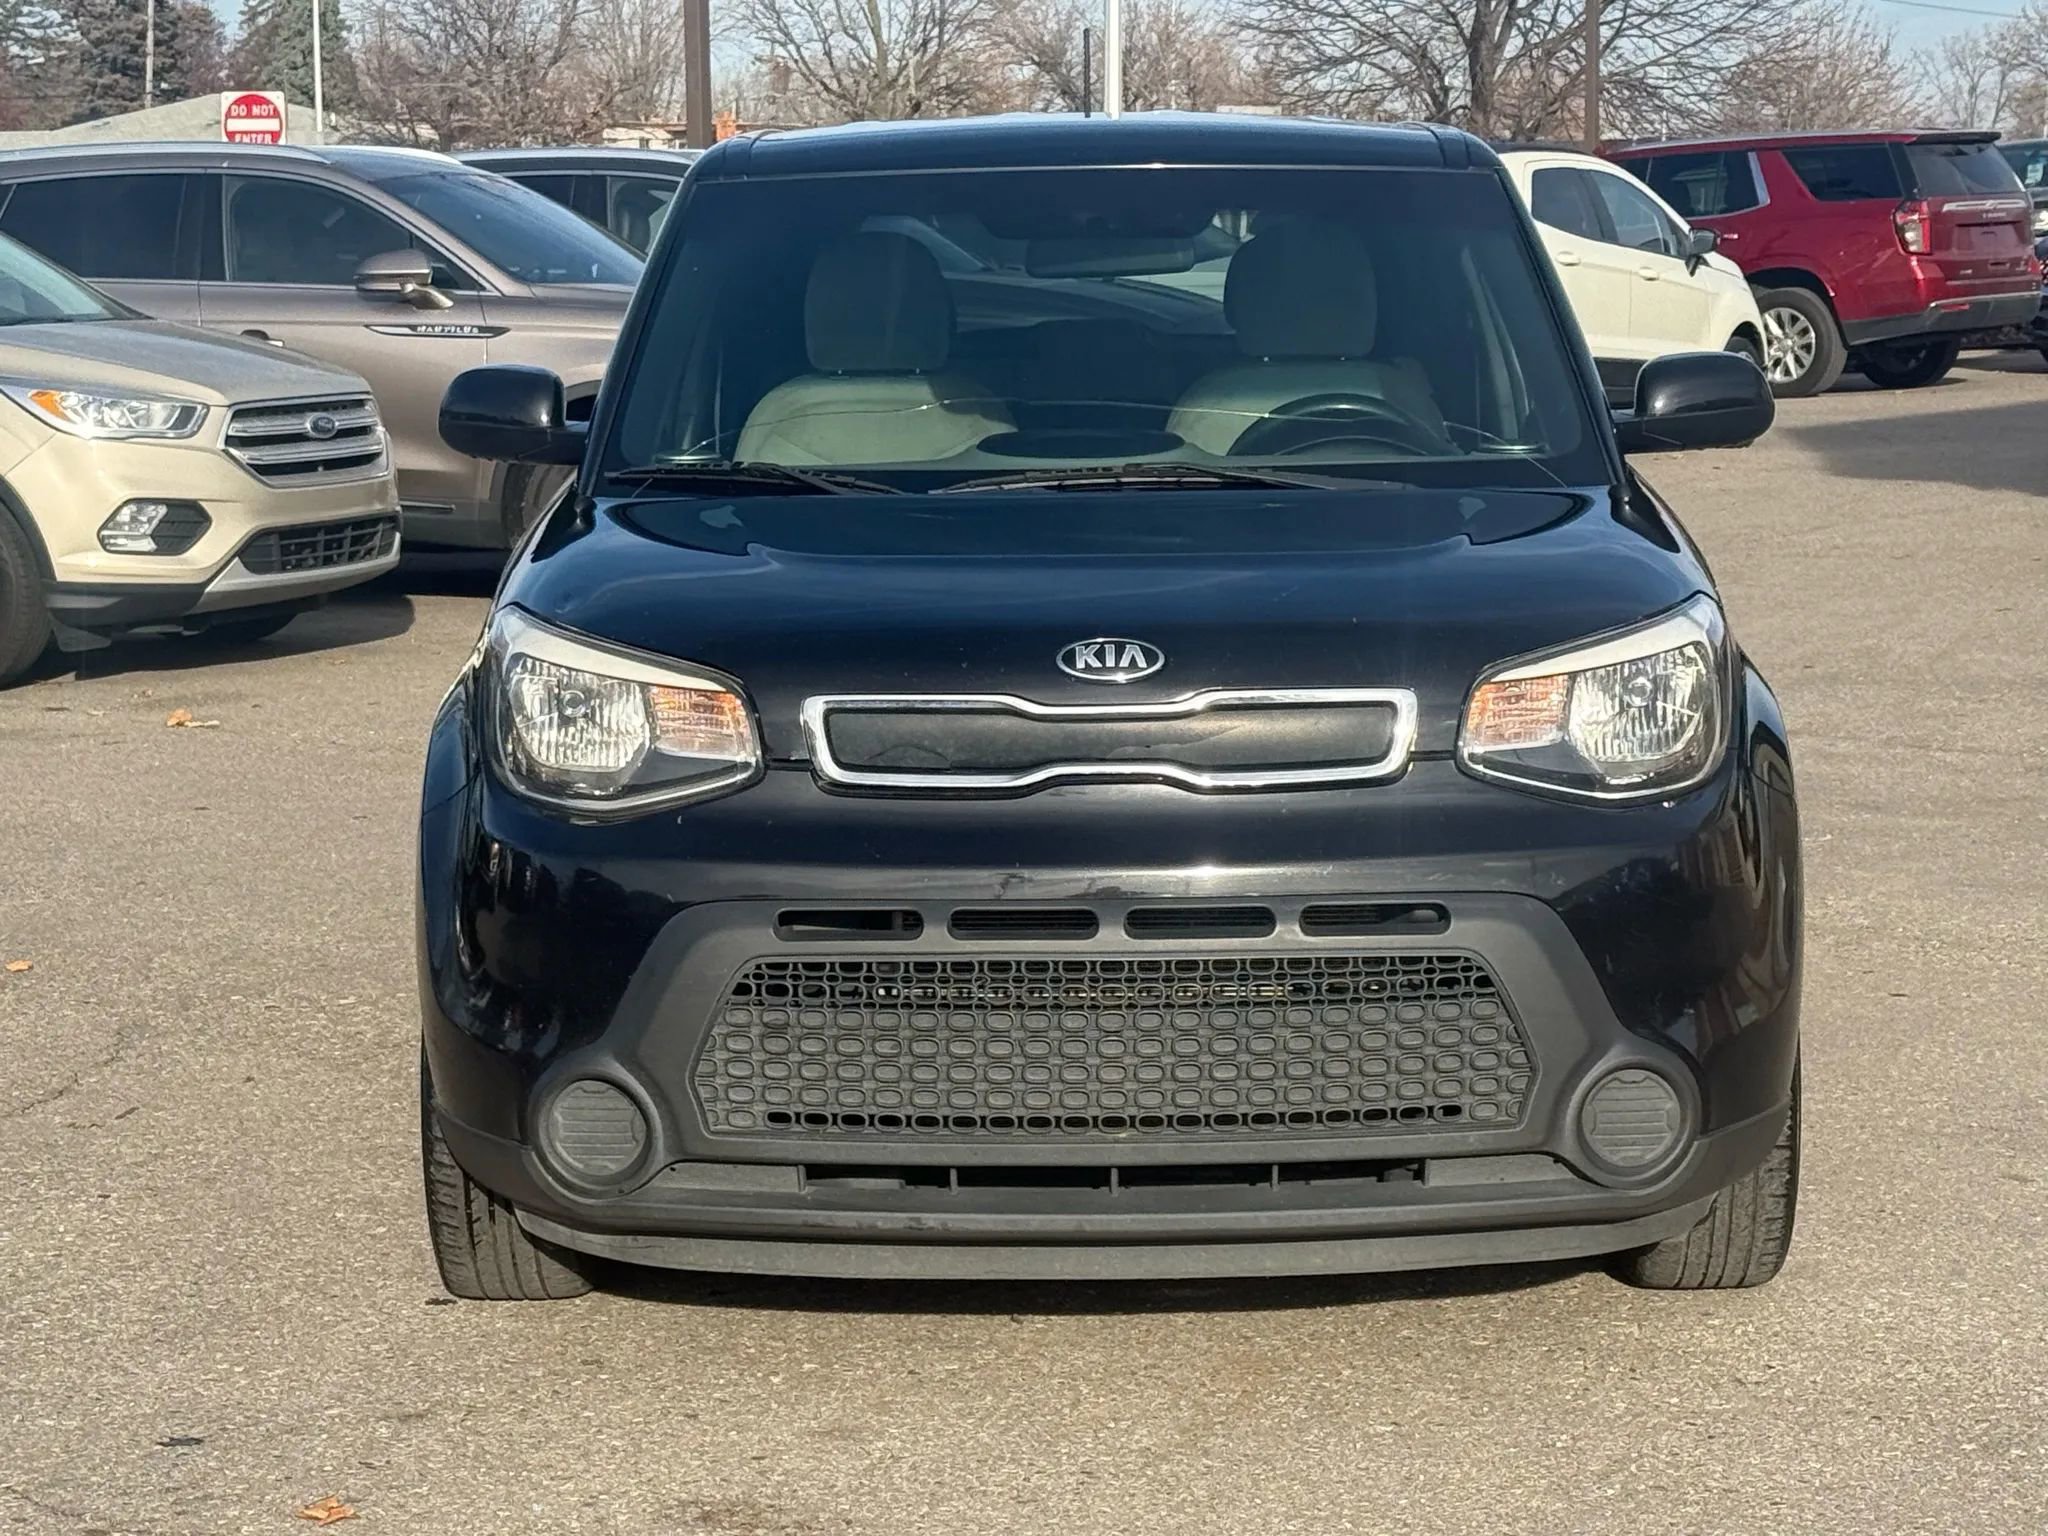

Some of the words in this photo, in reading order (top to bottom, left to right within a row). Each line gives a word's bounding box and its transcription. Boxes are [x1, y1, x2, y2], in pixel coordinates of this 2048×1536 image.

[231, 104, 247, 116] DO
[252, 104, 275, 116] NOT
[234, 133, 272, 144] ENTER
[417, 325, 479, 334] NAUTILUS
[1075, 644, 1147, 669] KIA
